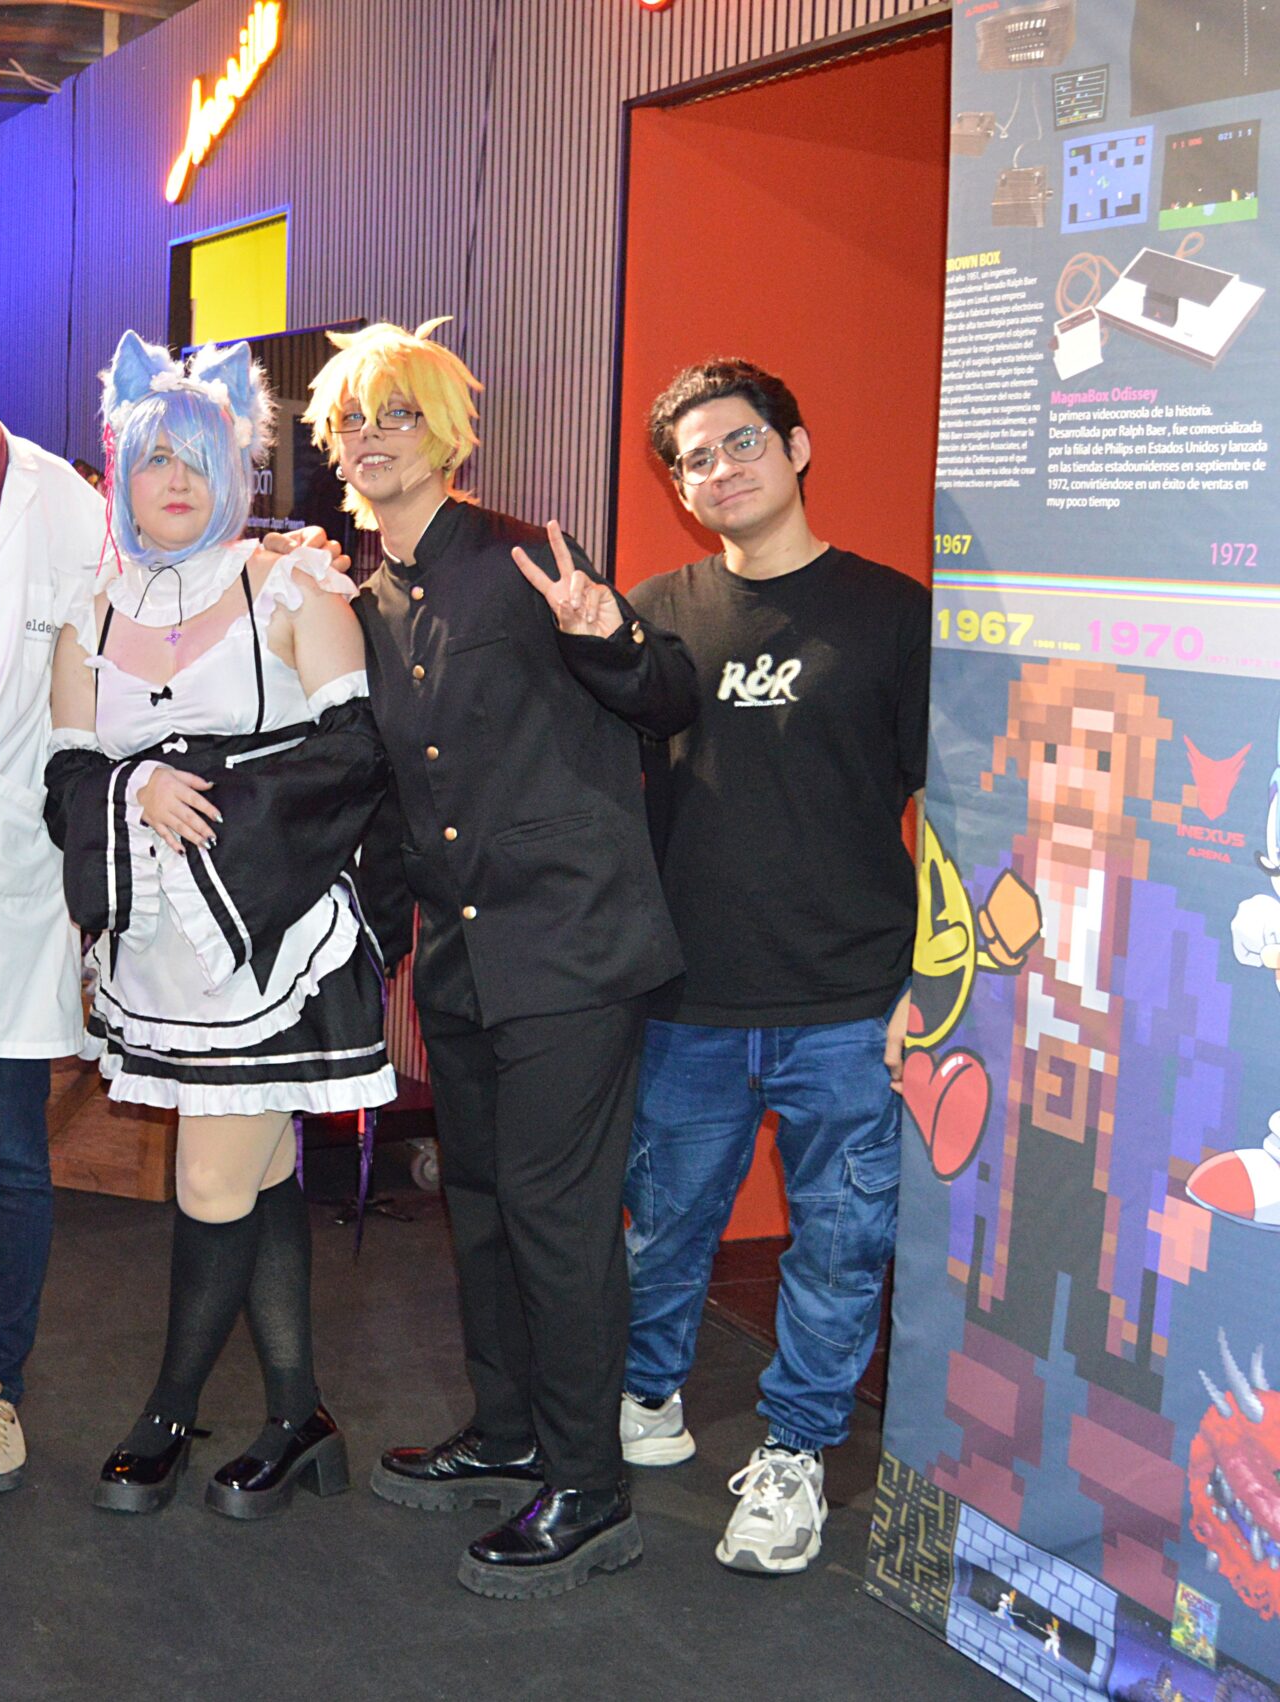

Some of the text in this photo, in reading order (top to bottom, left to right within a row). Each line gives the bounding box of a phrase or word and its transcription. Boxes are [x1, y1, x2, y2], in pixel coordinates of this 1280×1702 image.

[979, 251, 1001, 267] BOX
[1051, 386, 1158, 407] MagnaBox Odissey
[1058, 410, 1091, 424] primera
[1093, 408, 1150, 421] videoconsola
[1151, 406, 1164, 418] de
[1165, 406, 1174, 417] la
[1175, 404, 1213, 417] historia.
[1049, 421, 1263, 441] Desarrollada por Ralph Baer fue comercializada
[1048, 439, 1268, 458] por la filial de Philips en Estados Unidos y lanzada
[1048, 458, 1266, 474] en las tiendas estadounidenses en septiembre de
[1048, 477, 1249, 492] 1972, convirtiéndose en un éxito de ventas en
[1046, 496, 1120, 510] muy poco tiempo
[933, 533, 972, 556] 1967
[1209, 542, 1257, 567] 1972
[25, 619, 52, 634] elde
[936, 608, 1034, 646] 1967
[1087, 618, 1205, 662] 1970
[717, 653, 801, 701] R&R
